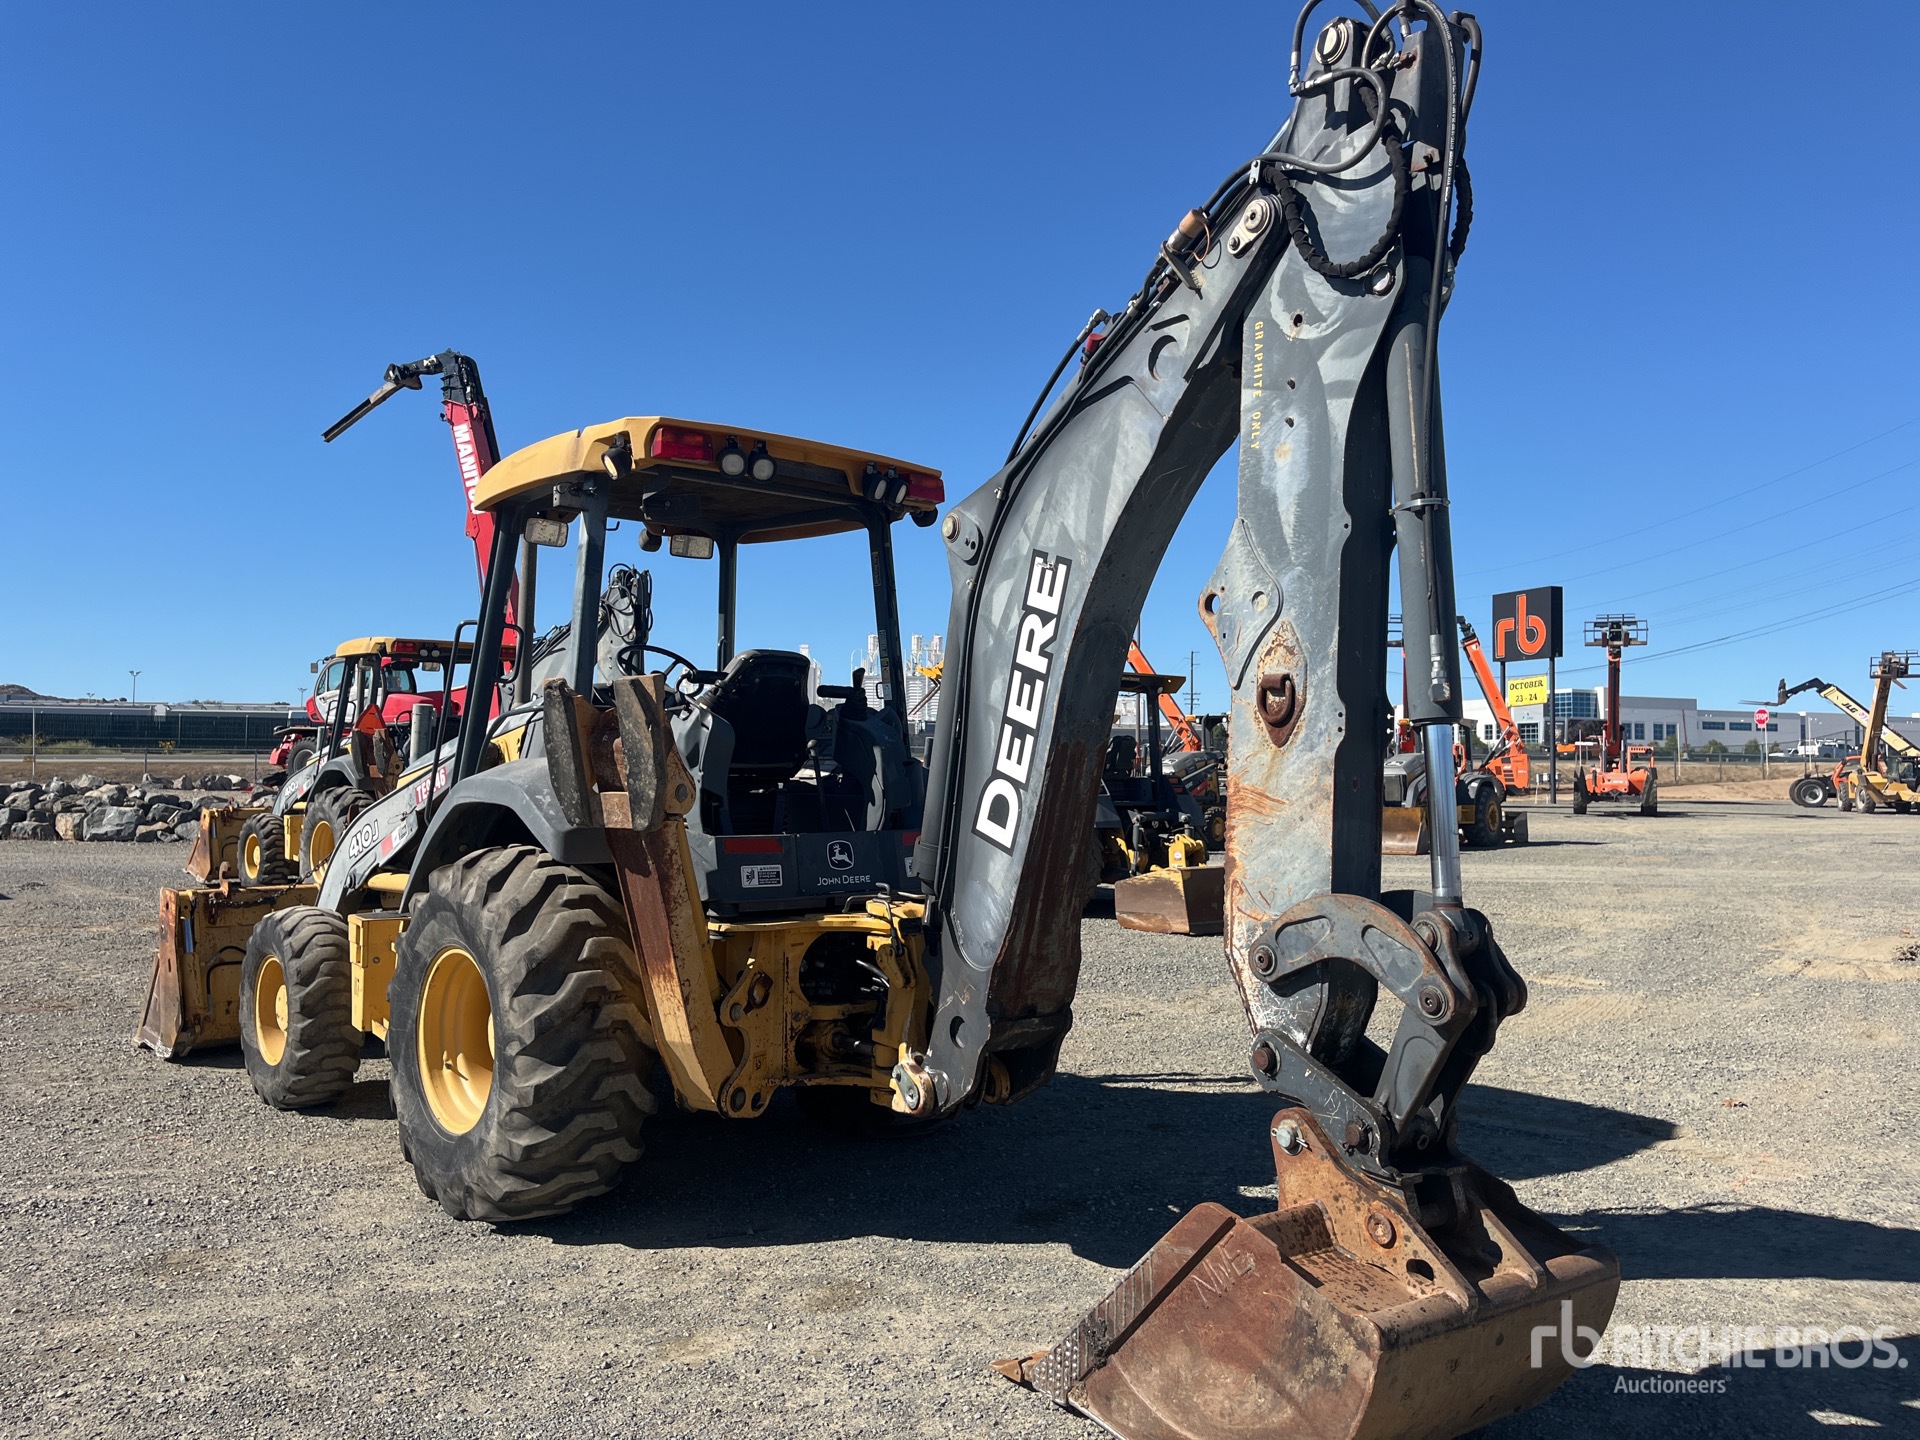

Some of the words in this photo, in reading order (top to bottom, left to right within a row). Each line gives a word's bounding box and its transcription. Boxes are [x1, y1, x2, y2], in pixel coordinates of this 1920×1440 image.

[1253, 321, 1264, 398] GRAPHITE
[1250, 411, 1262, 449] ONLY
[1495, 594, 1547, 659] rb
[1509, 680, 1543, 690] OCTOBER
[1515, 694, 1524, 702] 23
[1529, 693, 1538, 701] 24
[973, 551, 1070, 854] DEERE
[1841, 702, 1858, 714] JLG
[1755, 712, 1768, 721] STOP
[349, 819, 380, 859] 410J
[817, 876, 841, 887] JOHN
[842, 874, 871, 884] DEERE
